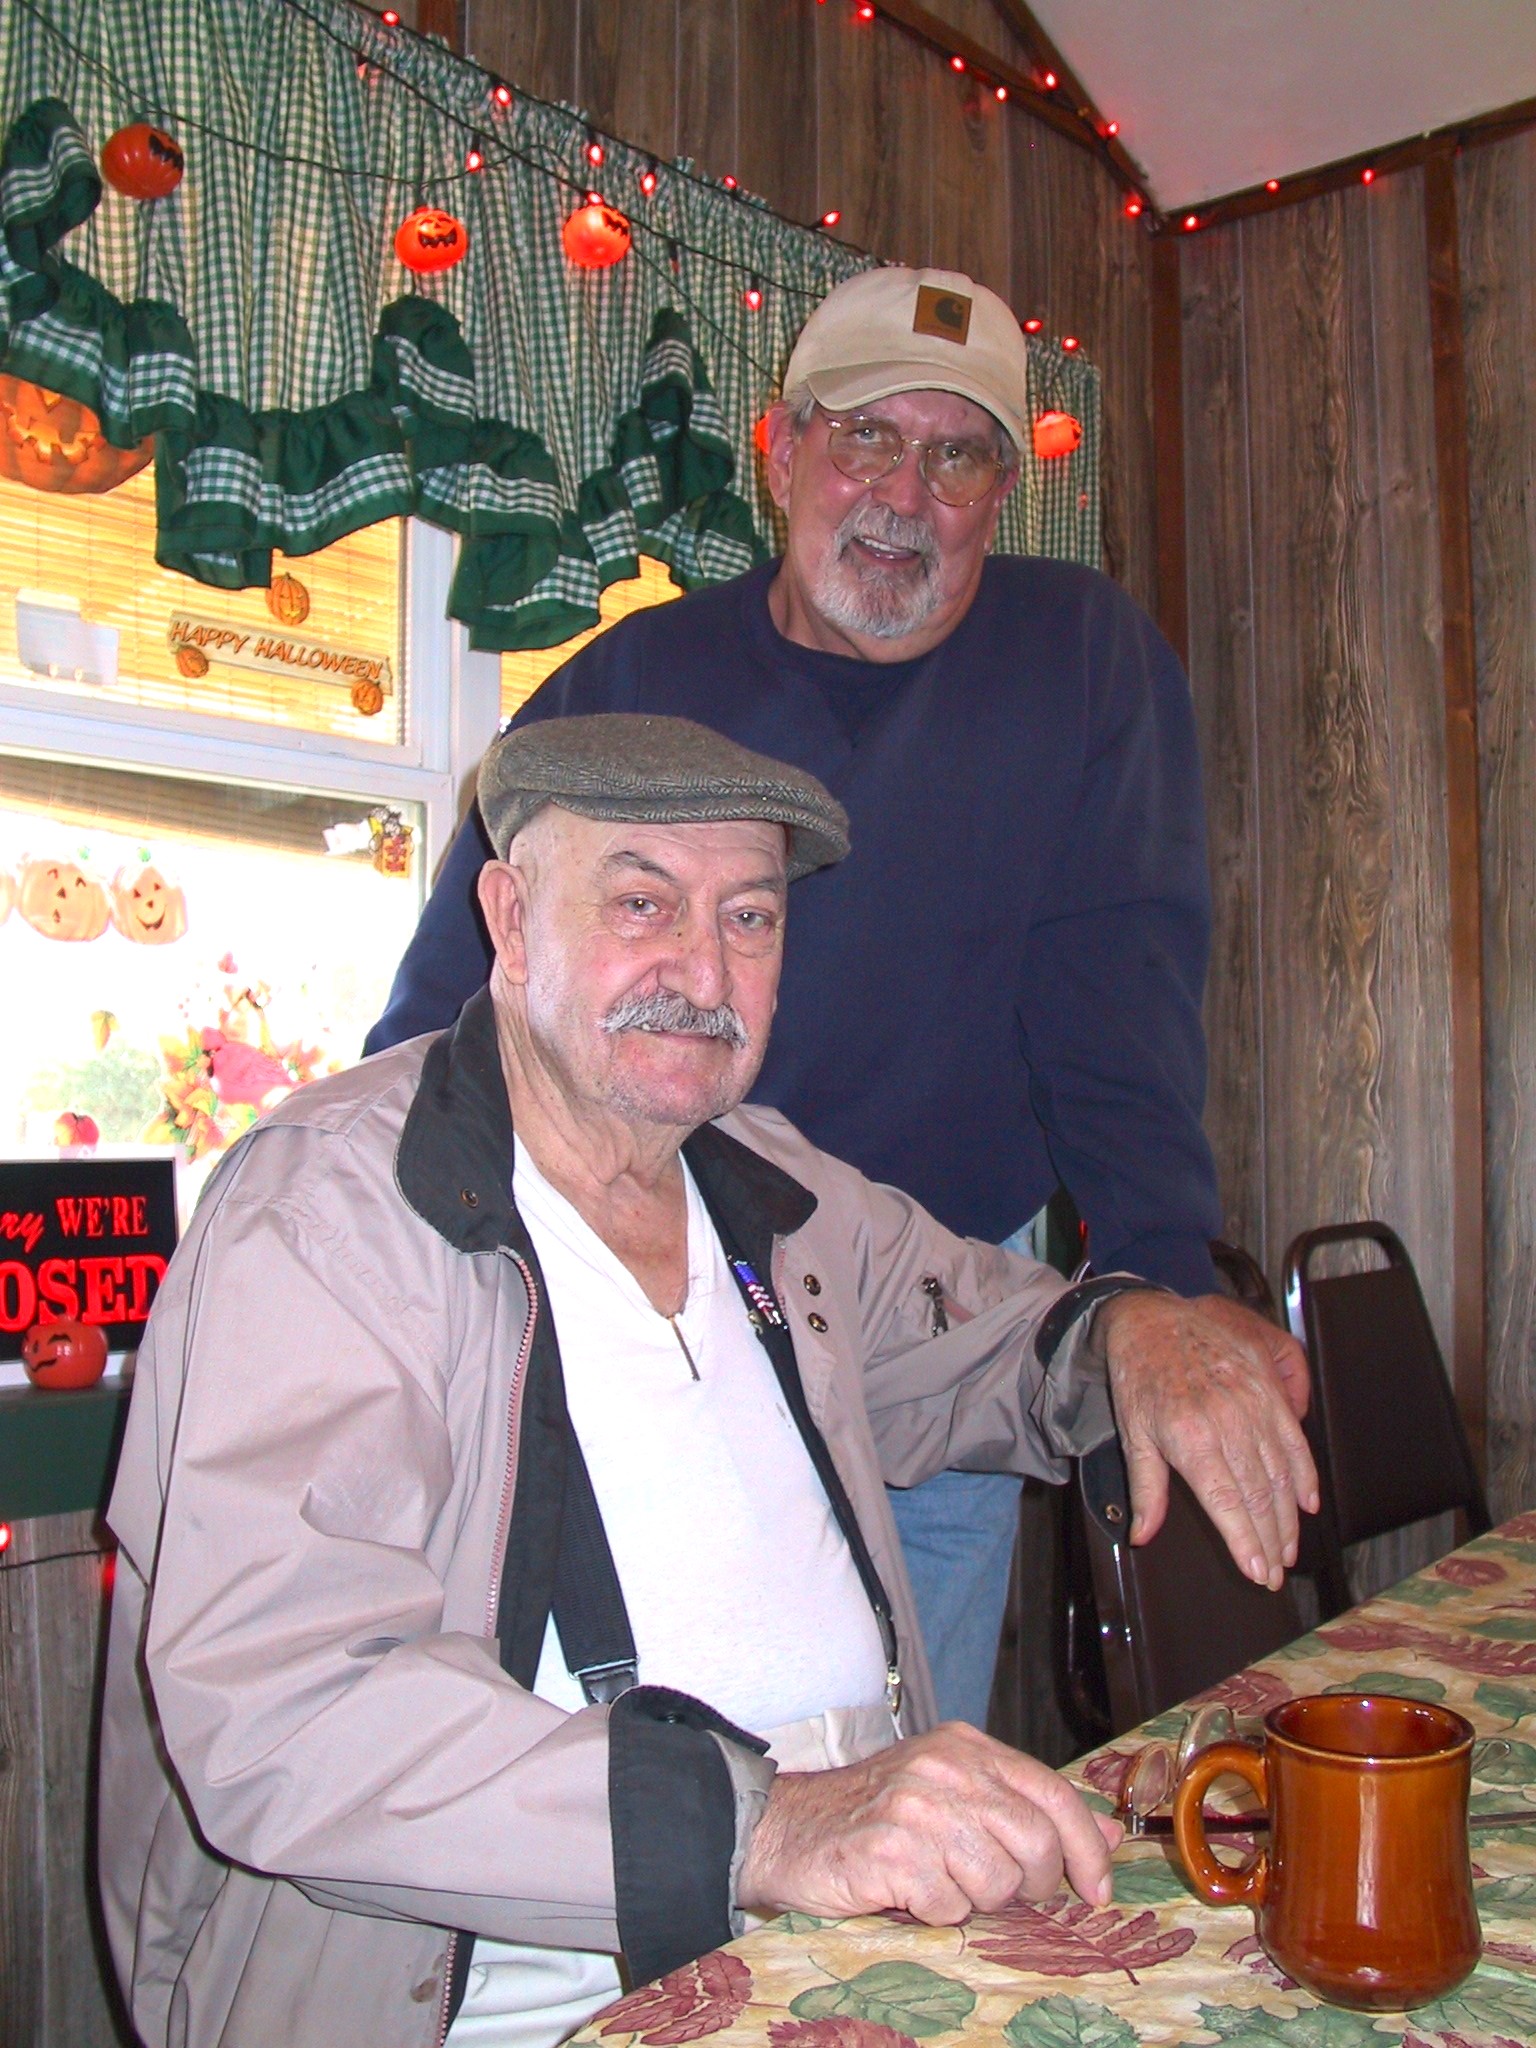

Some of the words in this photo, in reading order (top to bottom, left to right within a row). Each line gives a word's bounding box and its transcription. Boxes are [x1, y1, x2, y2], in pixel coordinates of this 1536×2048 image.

[171, 620, 250, 655] HAPPY
[253, 636, 383, 680] HALLOWEEN
[56, 1196, 149, 1237] WE'RE
